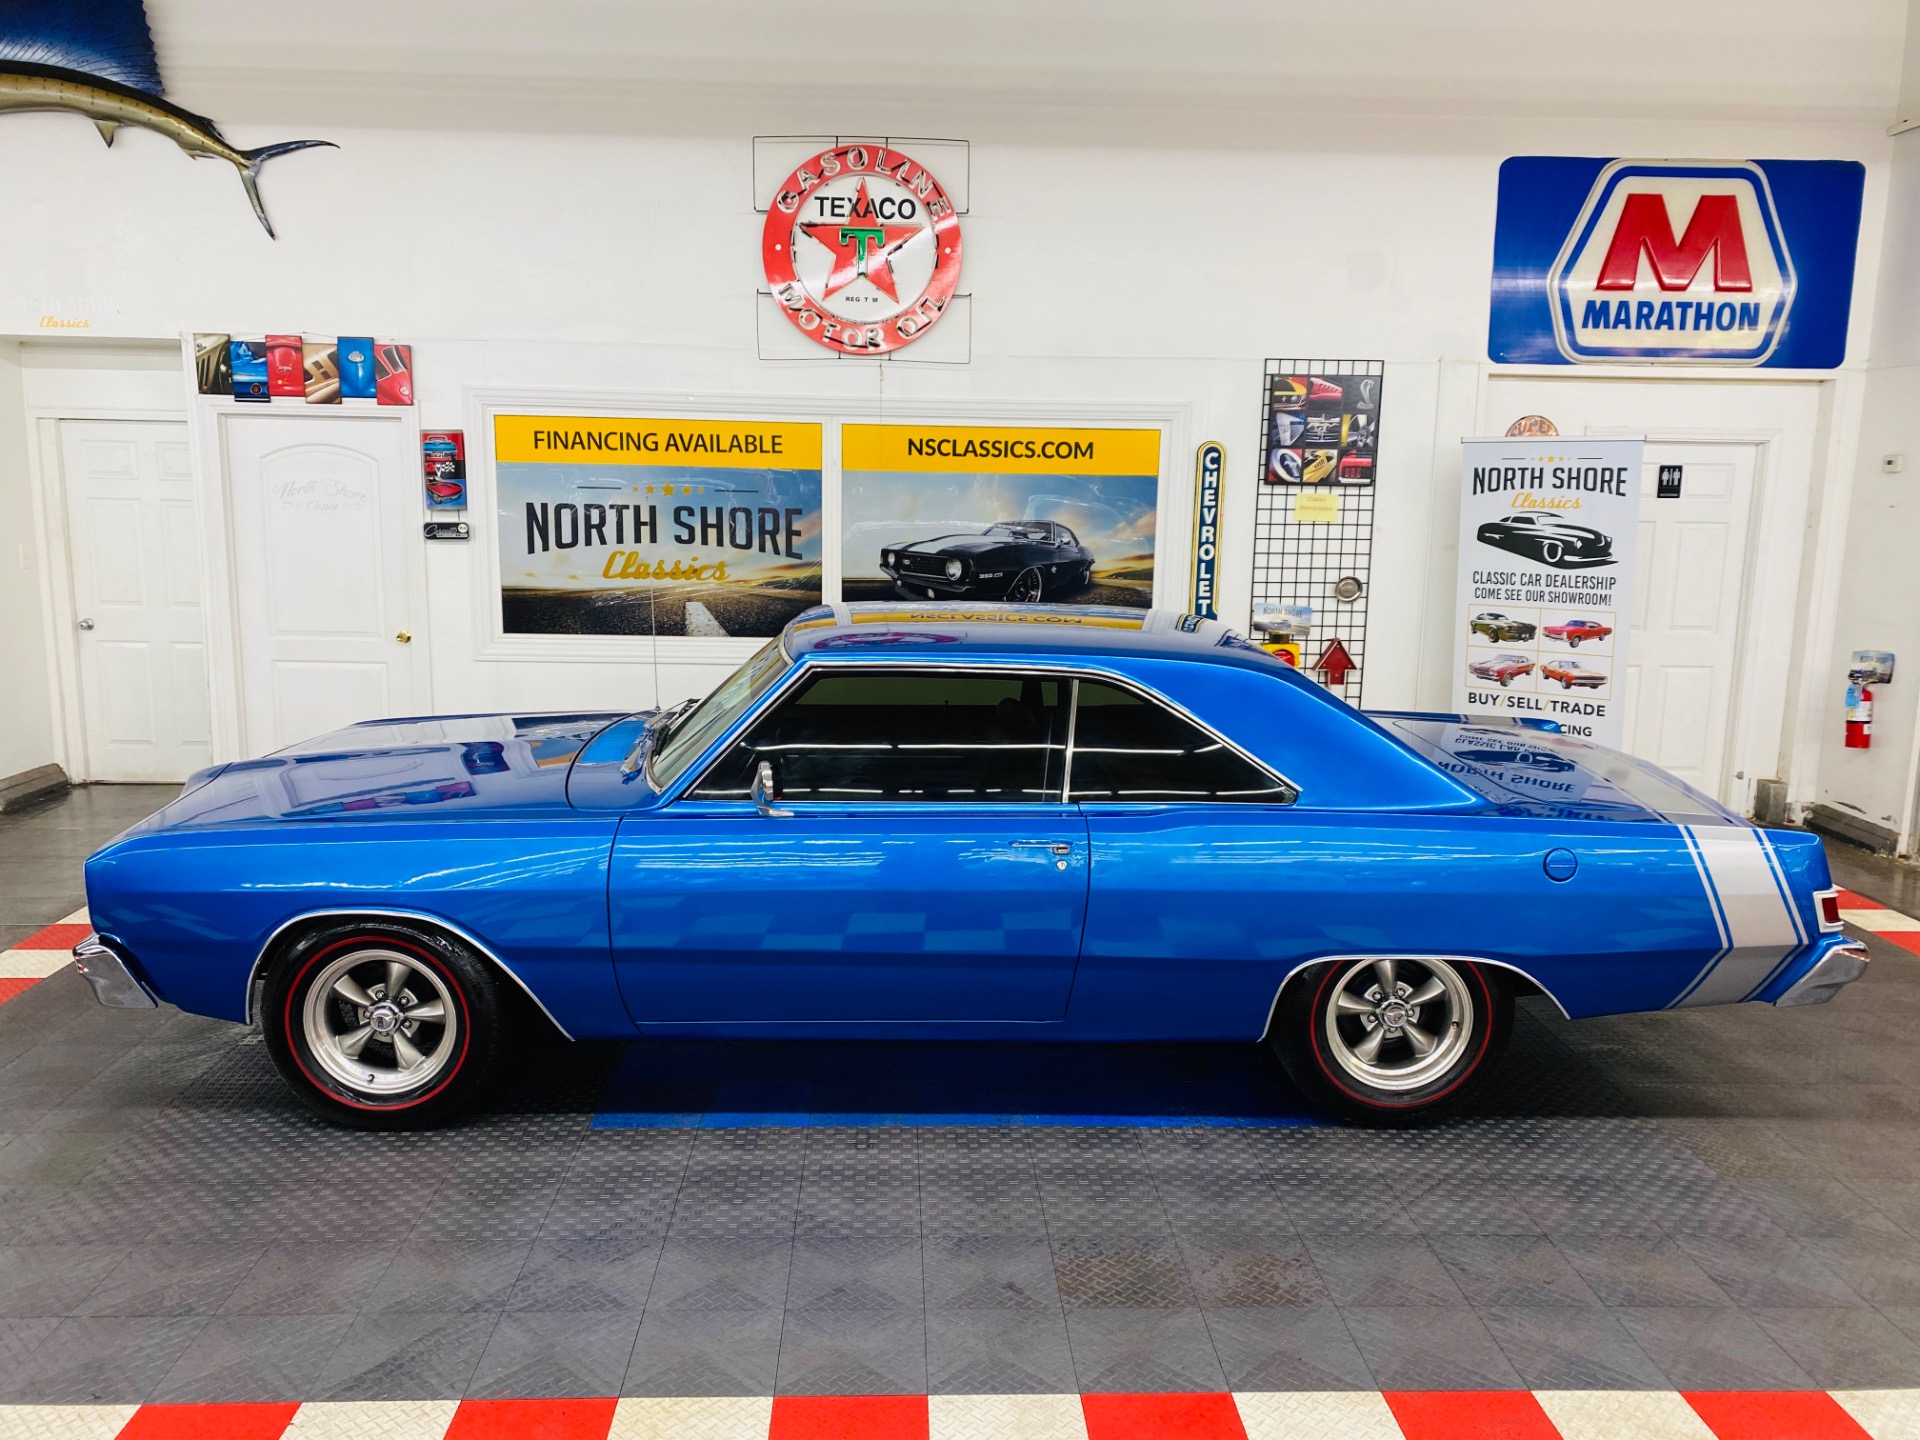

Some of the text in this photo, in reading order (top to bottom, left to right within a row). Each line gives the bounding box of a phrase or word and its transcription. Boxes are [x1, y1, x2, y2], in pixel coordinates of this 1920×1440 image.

[777, 146, 952, 222] GASOLINE
[814, 196, 917, 220] TEXACO
[1593, 193, 1754, 292] M
[39, 315, 91, 328] Classics
[778, 283, 948, 352] MOTOR OIL
[1581, 299, 1761, 332] MARATHON
[533, 430, 784, 454] FINANCING AVAILABLE
[907, 438, 1095, 460] NSCLASSICS.COM
[1472, 466, 1629, 497] NORTH SHORE
[1510, 492, 1582, 510] Classics
[525, 502, 804, 561] NORTH SHORE
[1197, 452, 1219, 616] CHEVROLET
[602, 550, 731, 582] Classics
[1472, 570, 1617, 590] CLASSIC CAR DEALERSHIP
[1474, 587, 1612, 606] COME SEE OUR SHOWROOM!
